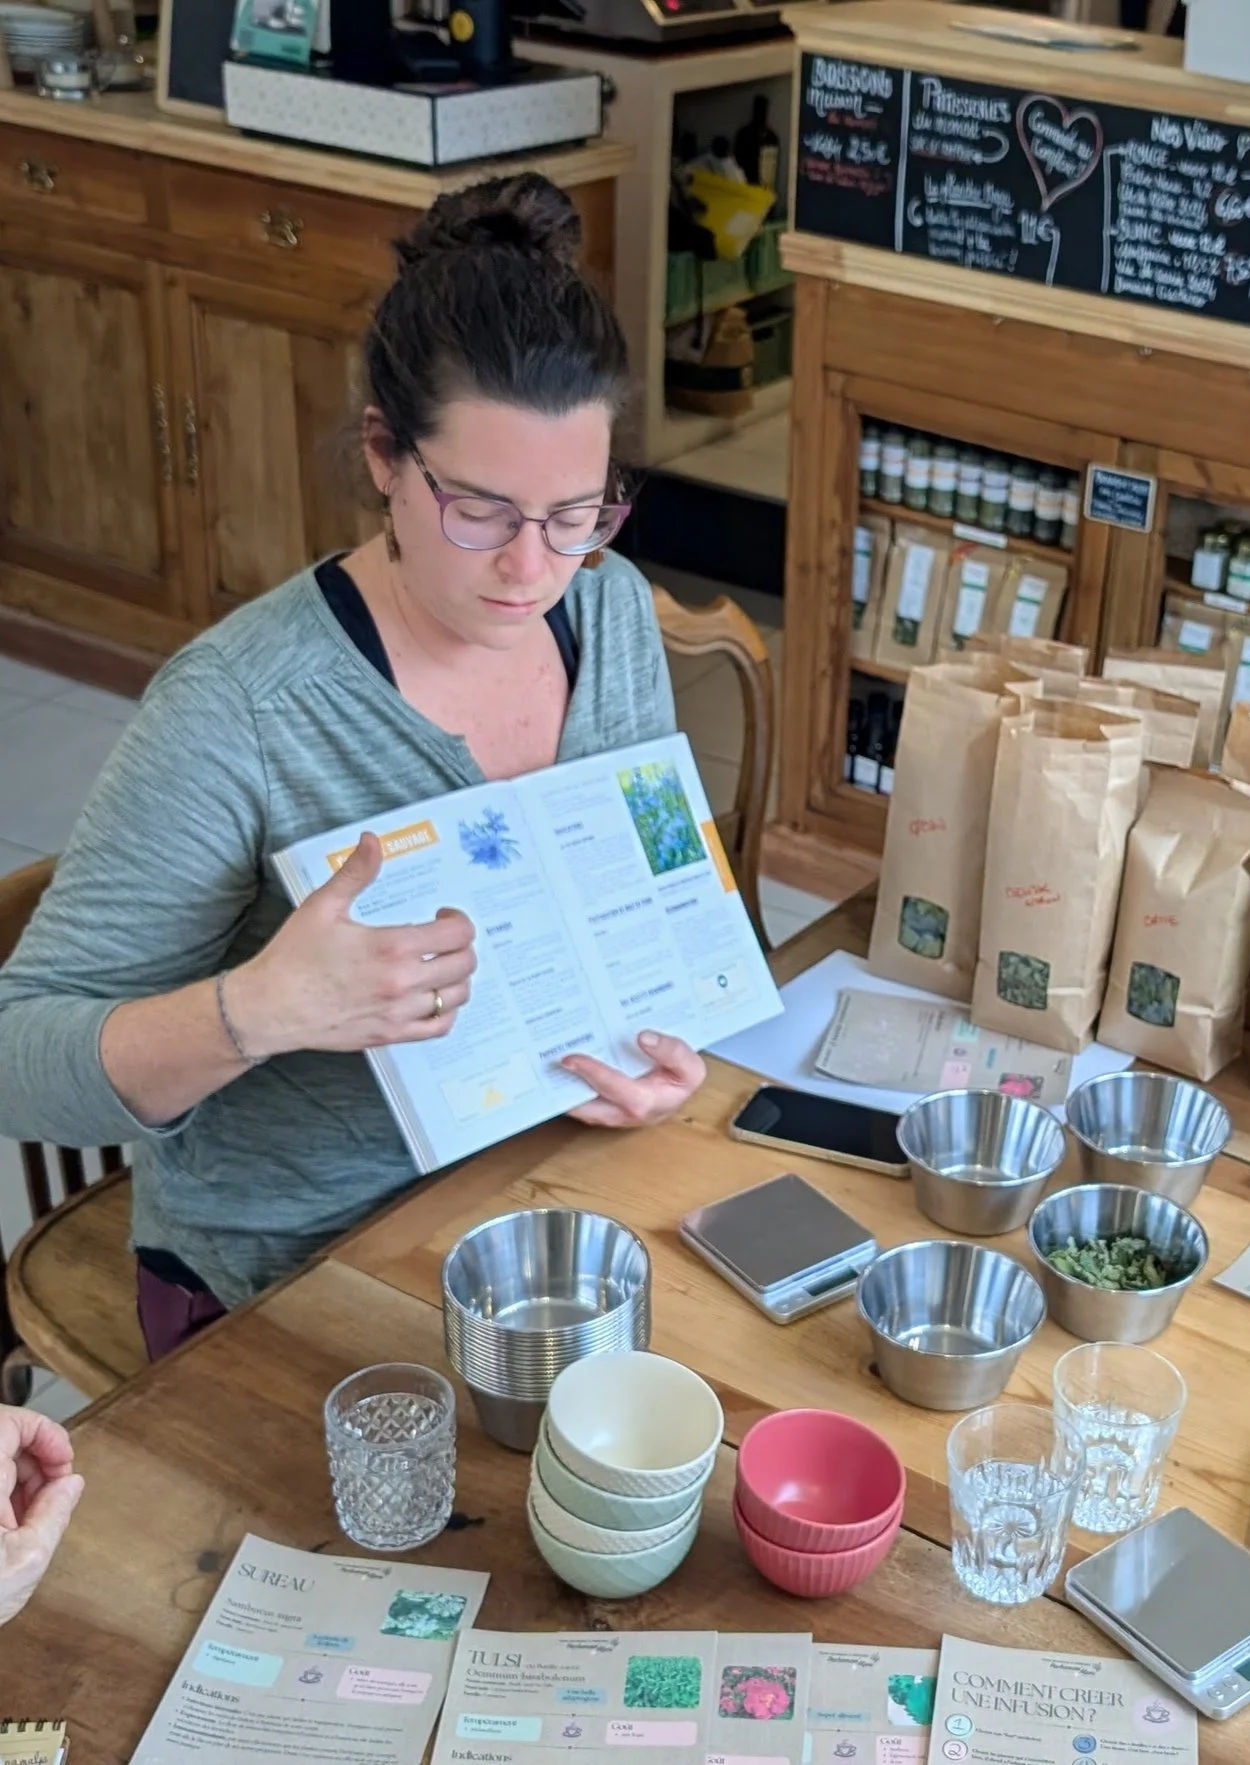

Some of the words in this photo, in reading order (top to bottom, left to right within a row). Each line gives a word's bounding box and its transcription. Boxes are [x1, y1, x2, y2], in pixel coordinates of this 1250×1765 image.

[238, 1563, 315, 1592] SUREAU
[468, 1649, 522, 1668] TULSI
[182, 1680, 240, 1703] Indications
[953, 1670, 1057, 1699] COMMENT
[1060, 1687, 1125, 1707] CREER
[951, 1687, 990, 1708] UNE
[994, 1696, 1084, 1721] INFUSION
[1087, 1708, 1097, 1722] ?
[952, 1718, 965, 1730] 1
[451, 1749, 512, 1762] Indications
[948, 1742, 962, 1756] 2
